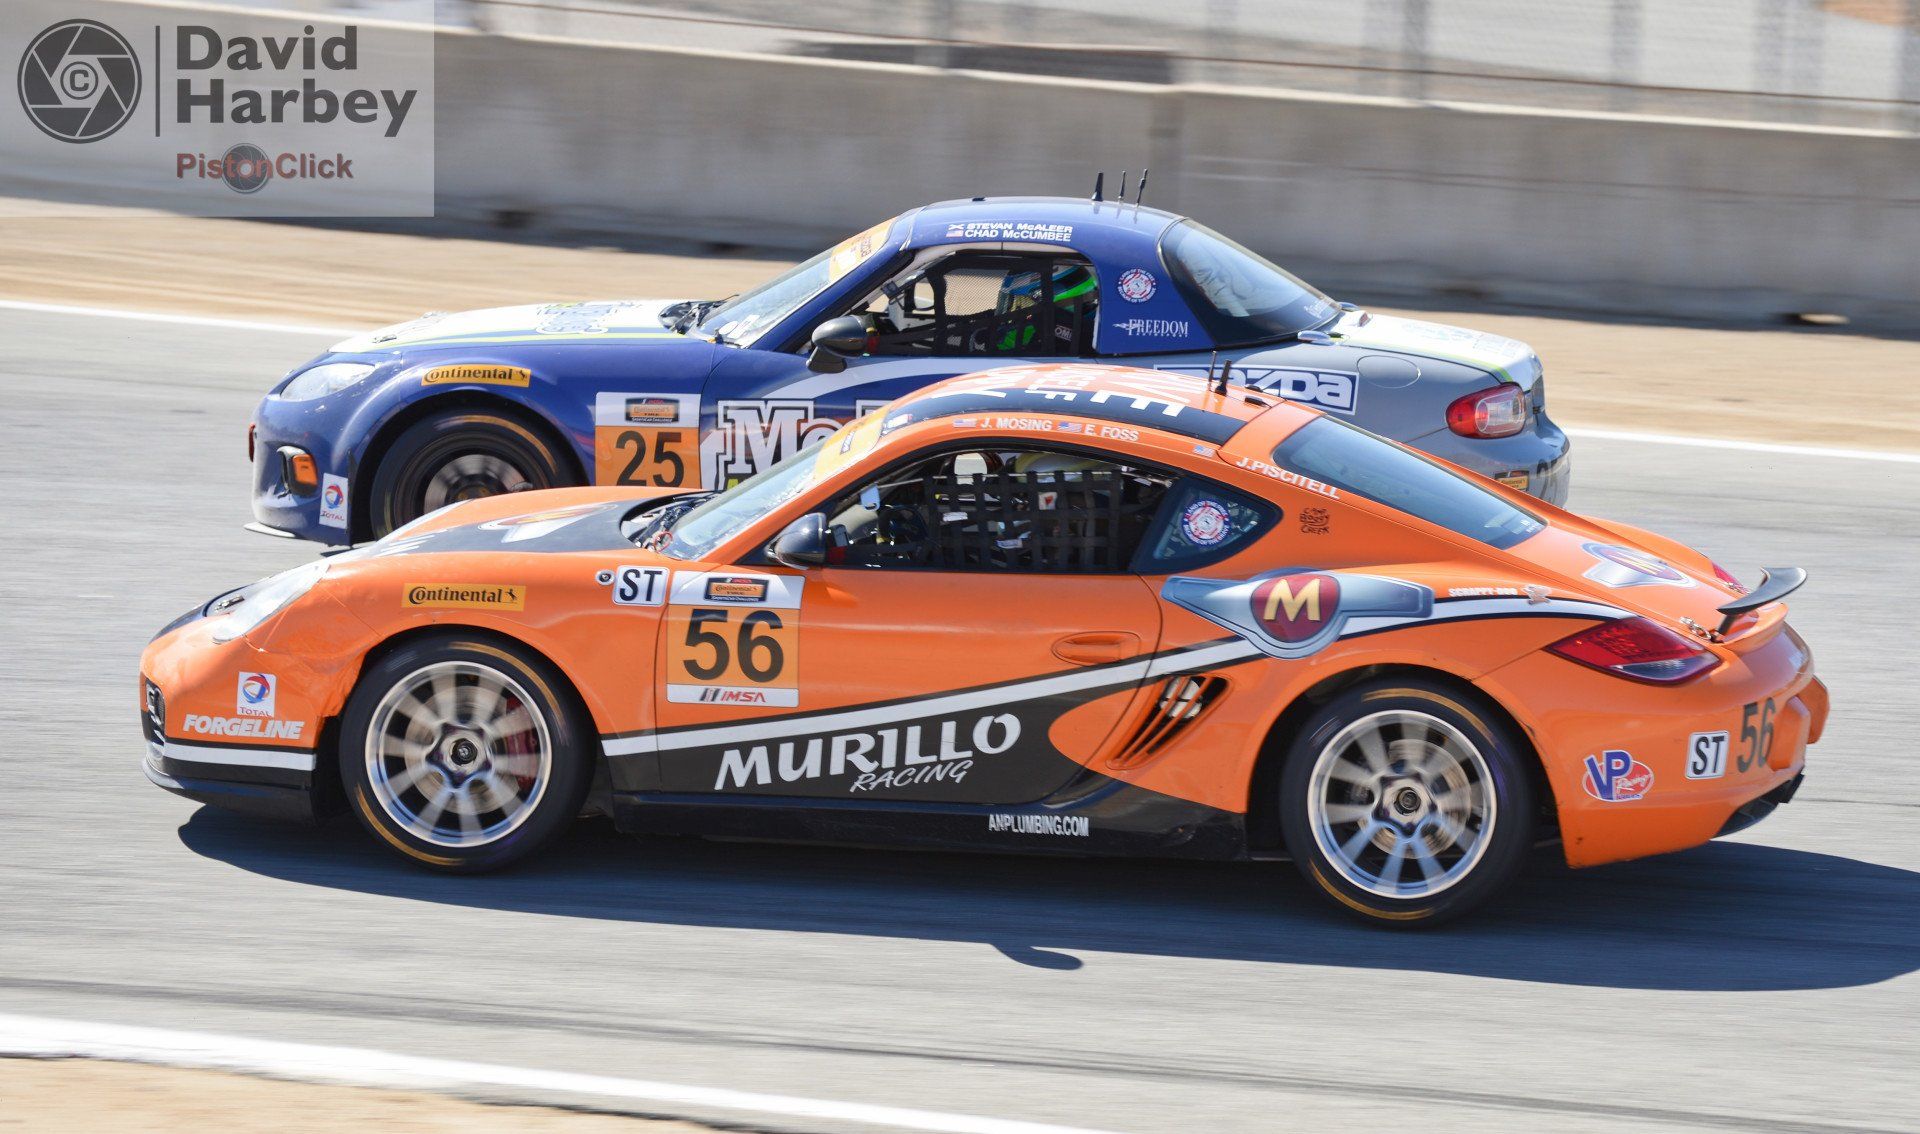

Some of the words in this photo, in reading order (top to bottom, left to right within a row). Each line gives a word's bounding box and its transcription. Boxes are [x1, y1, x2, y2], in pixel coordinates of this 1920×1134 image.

[965, 229, 998, 238] CHAD
[1002, 230, 1072, 242] McCUMBEE
[1128, 319, 1189, 336] FREEDOM
[424, 367, 513, 383] Continental
[981, 418, 992, 429] J.
[996, 418, 1053, 431] MOSING
[1085, 424, 1097, 436] E.
[1101, 426, 1139, 441] FOSS
[615, 430, 684, 487] 25
[321, 511, 344, 521] TOTAL
[409, 586, 502, 604] Continental
[619, 568, 662, 602] ST
[1263, 578, 1321, 622] M
[683, 608, 784, 683] 56
[720, 690, 766, 703] IMSA
[240, 706, 271, 717] TOTAL
[183, 714, 305, 739] FORGELINE
[1737, 697, 1776, 773] 56
[714, 713, 1021, 790] MURILLO
[1693, 736, 1724, 775] ST
[850, 760, 973, 793] RACING
[1586, 751, 1631, 800] VP
